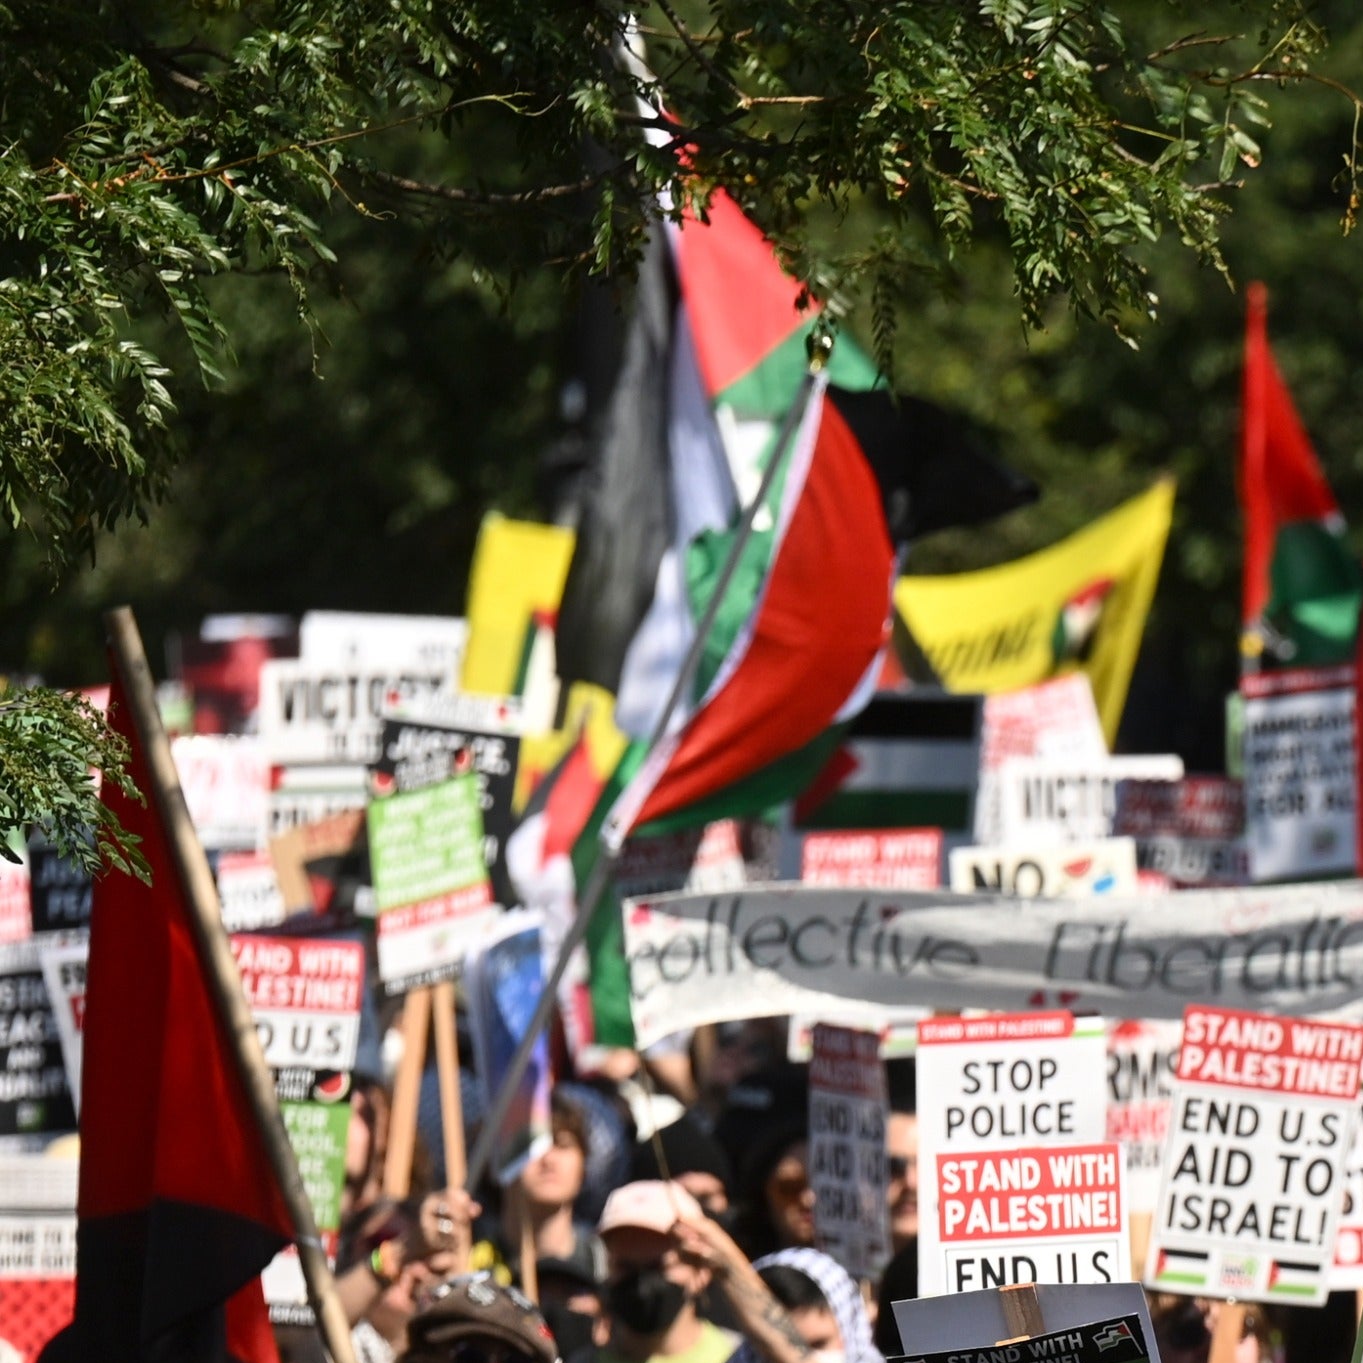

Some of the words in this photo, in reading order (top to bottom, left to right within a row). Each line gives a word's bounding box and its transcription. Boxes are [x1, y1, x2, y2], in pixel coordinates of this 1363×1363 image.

[1183, 1013, 1285, 1056] STAND
[961, 1057, 1059, 1096] STOP
[1177, 1046, 1361, 1098] PALESTINE!
[944, 1100, 1075, 1141] POLICE
[1180, 1097, 1260, 1138] END
[1279, 1107, 1341, 1148] U.S
[941, 1158, 1039, 1195] STAND
[1046, 1152, 1118, 1190] WITH
[1172, 1141, 1254, 1189] AID
[1276, 1154, 1335, 1199] TO
[943, 1193, 1118, 1236] PALESTINE!
[1165, 1193, 1330, 1248] ISRAEL!
[1028, 1332, 1084, 1359] WITH
